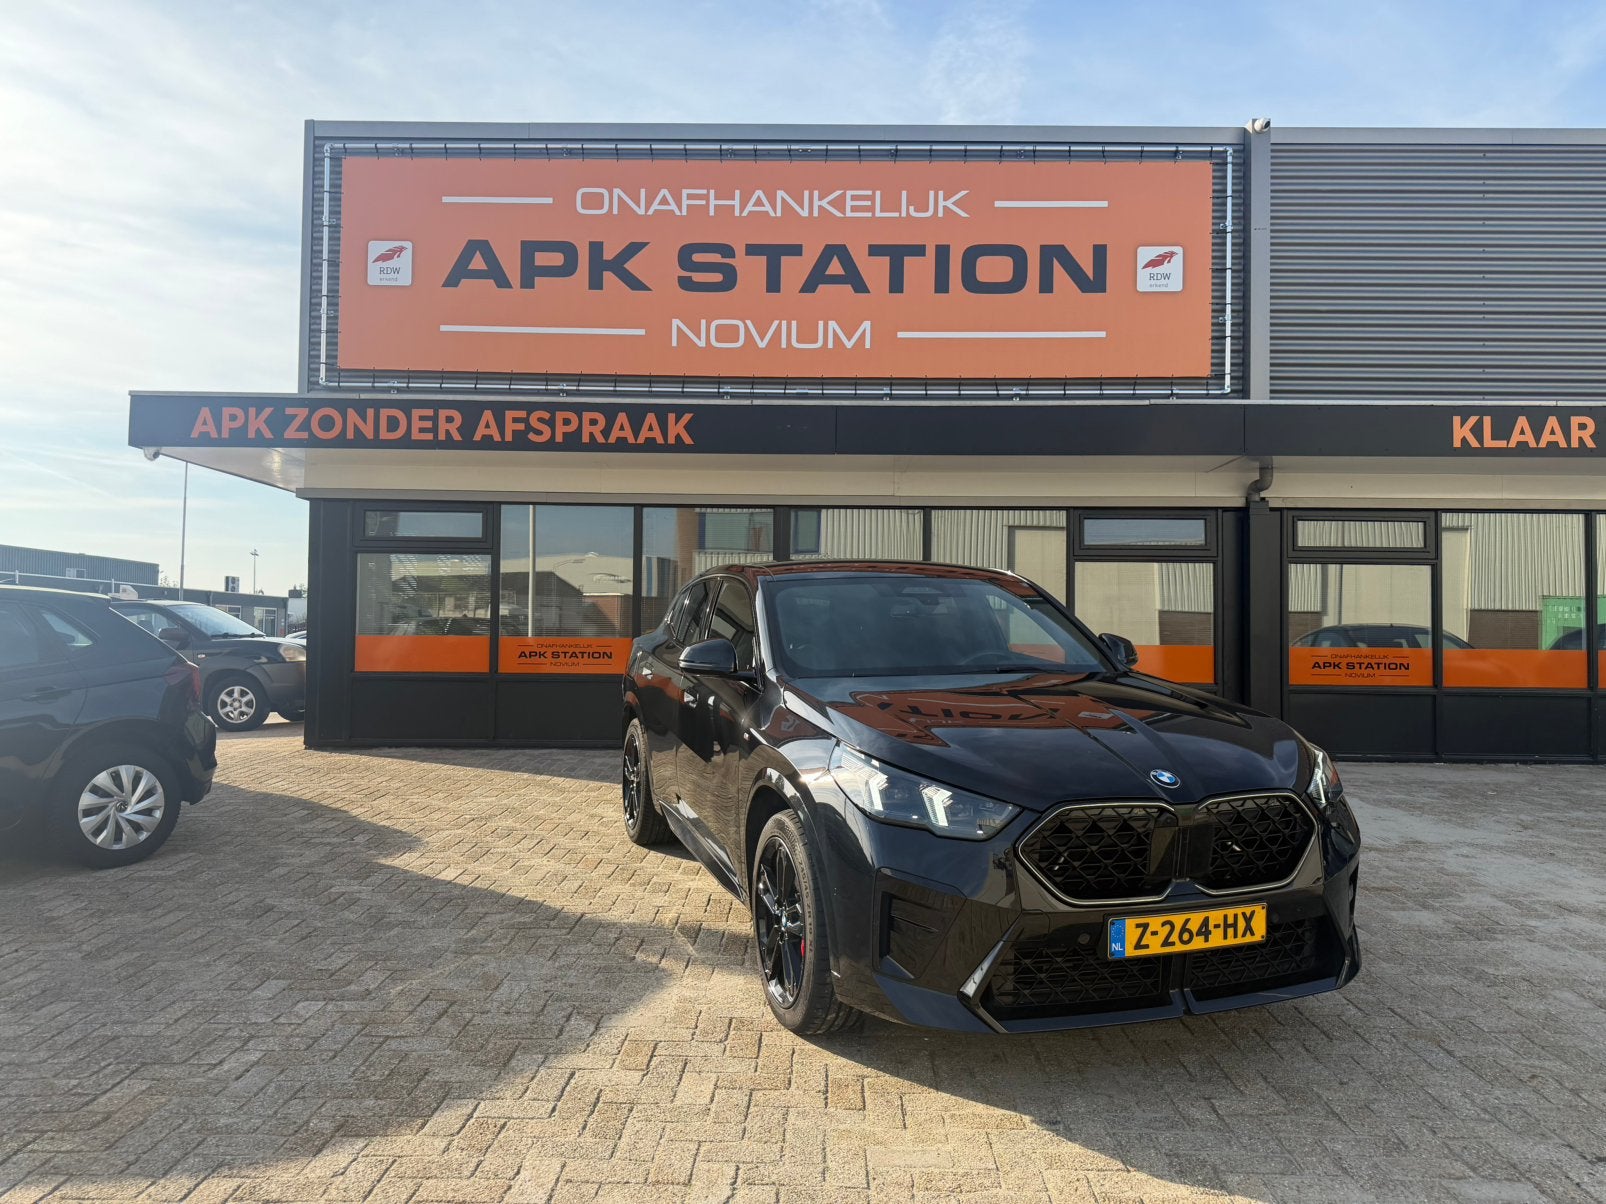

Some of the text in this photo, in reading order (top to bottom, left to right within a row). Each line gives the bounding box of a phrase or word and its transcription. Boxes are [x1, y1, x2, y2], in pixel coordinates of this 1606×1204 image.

[575, 187, 970, 218] ONAFHANKELIJK
[379, 266, 401, 275] RDW
[441, 239, 1108, 294] APK STATION
[1149, 272, 1172, 281] RDW
[671, 318, 871, 350] NOVIUM
[190, 406, 695, 446] APK ZONDER AFSPRAAK
[1452, 415, 1597, 449] KLAAR
[517, 651, 613, 659] APK STATION
[1311, 661, 1410, 671] APK STATION
[1111, 909, 1256, 951] NL Z-264-HX
